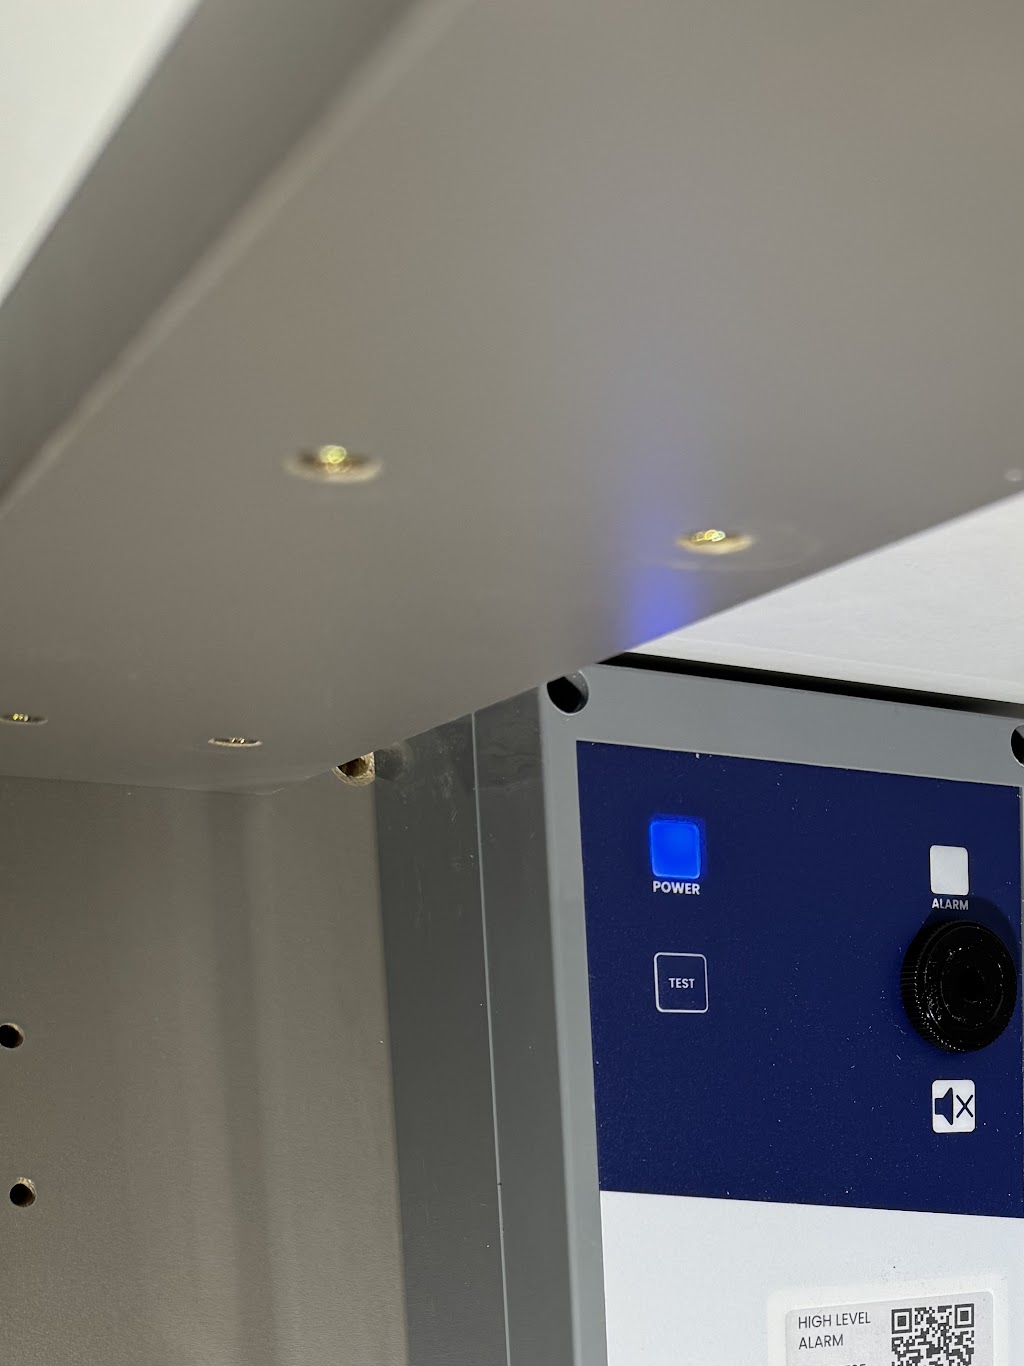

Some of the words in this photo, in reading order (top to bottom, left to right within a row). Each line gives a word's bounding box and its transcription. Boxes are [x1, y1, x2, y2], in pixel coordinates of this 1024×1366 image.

[653, 880, 701, 895] POWER
[931, 898, 969, 911] ALARM
[668, 977, 695, 989] TEST
[798, 1314, 832, 1329] HIGH
[836, 1311, 871, 1326] LEVEL
[798, 1333, 844, 1350] ALARM
